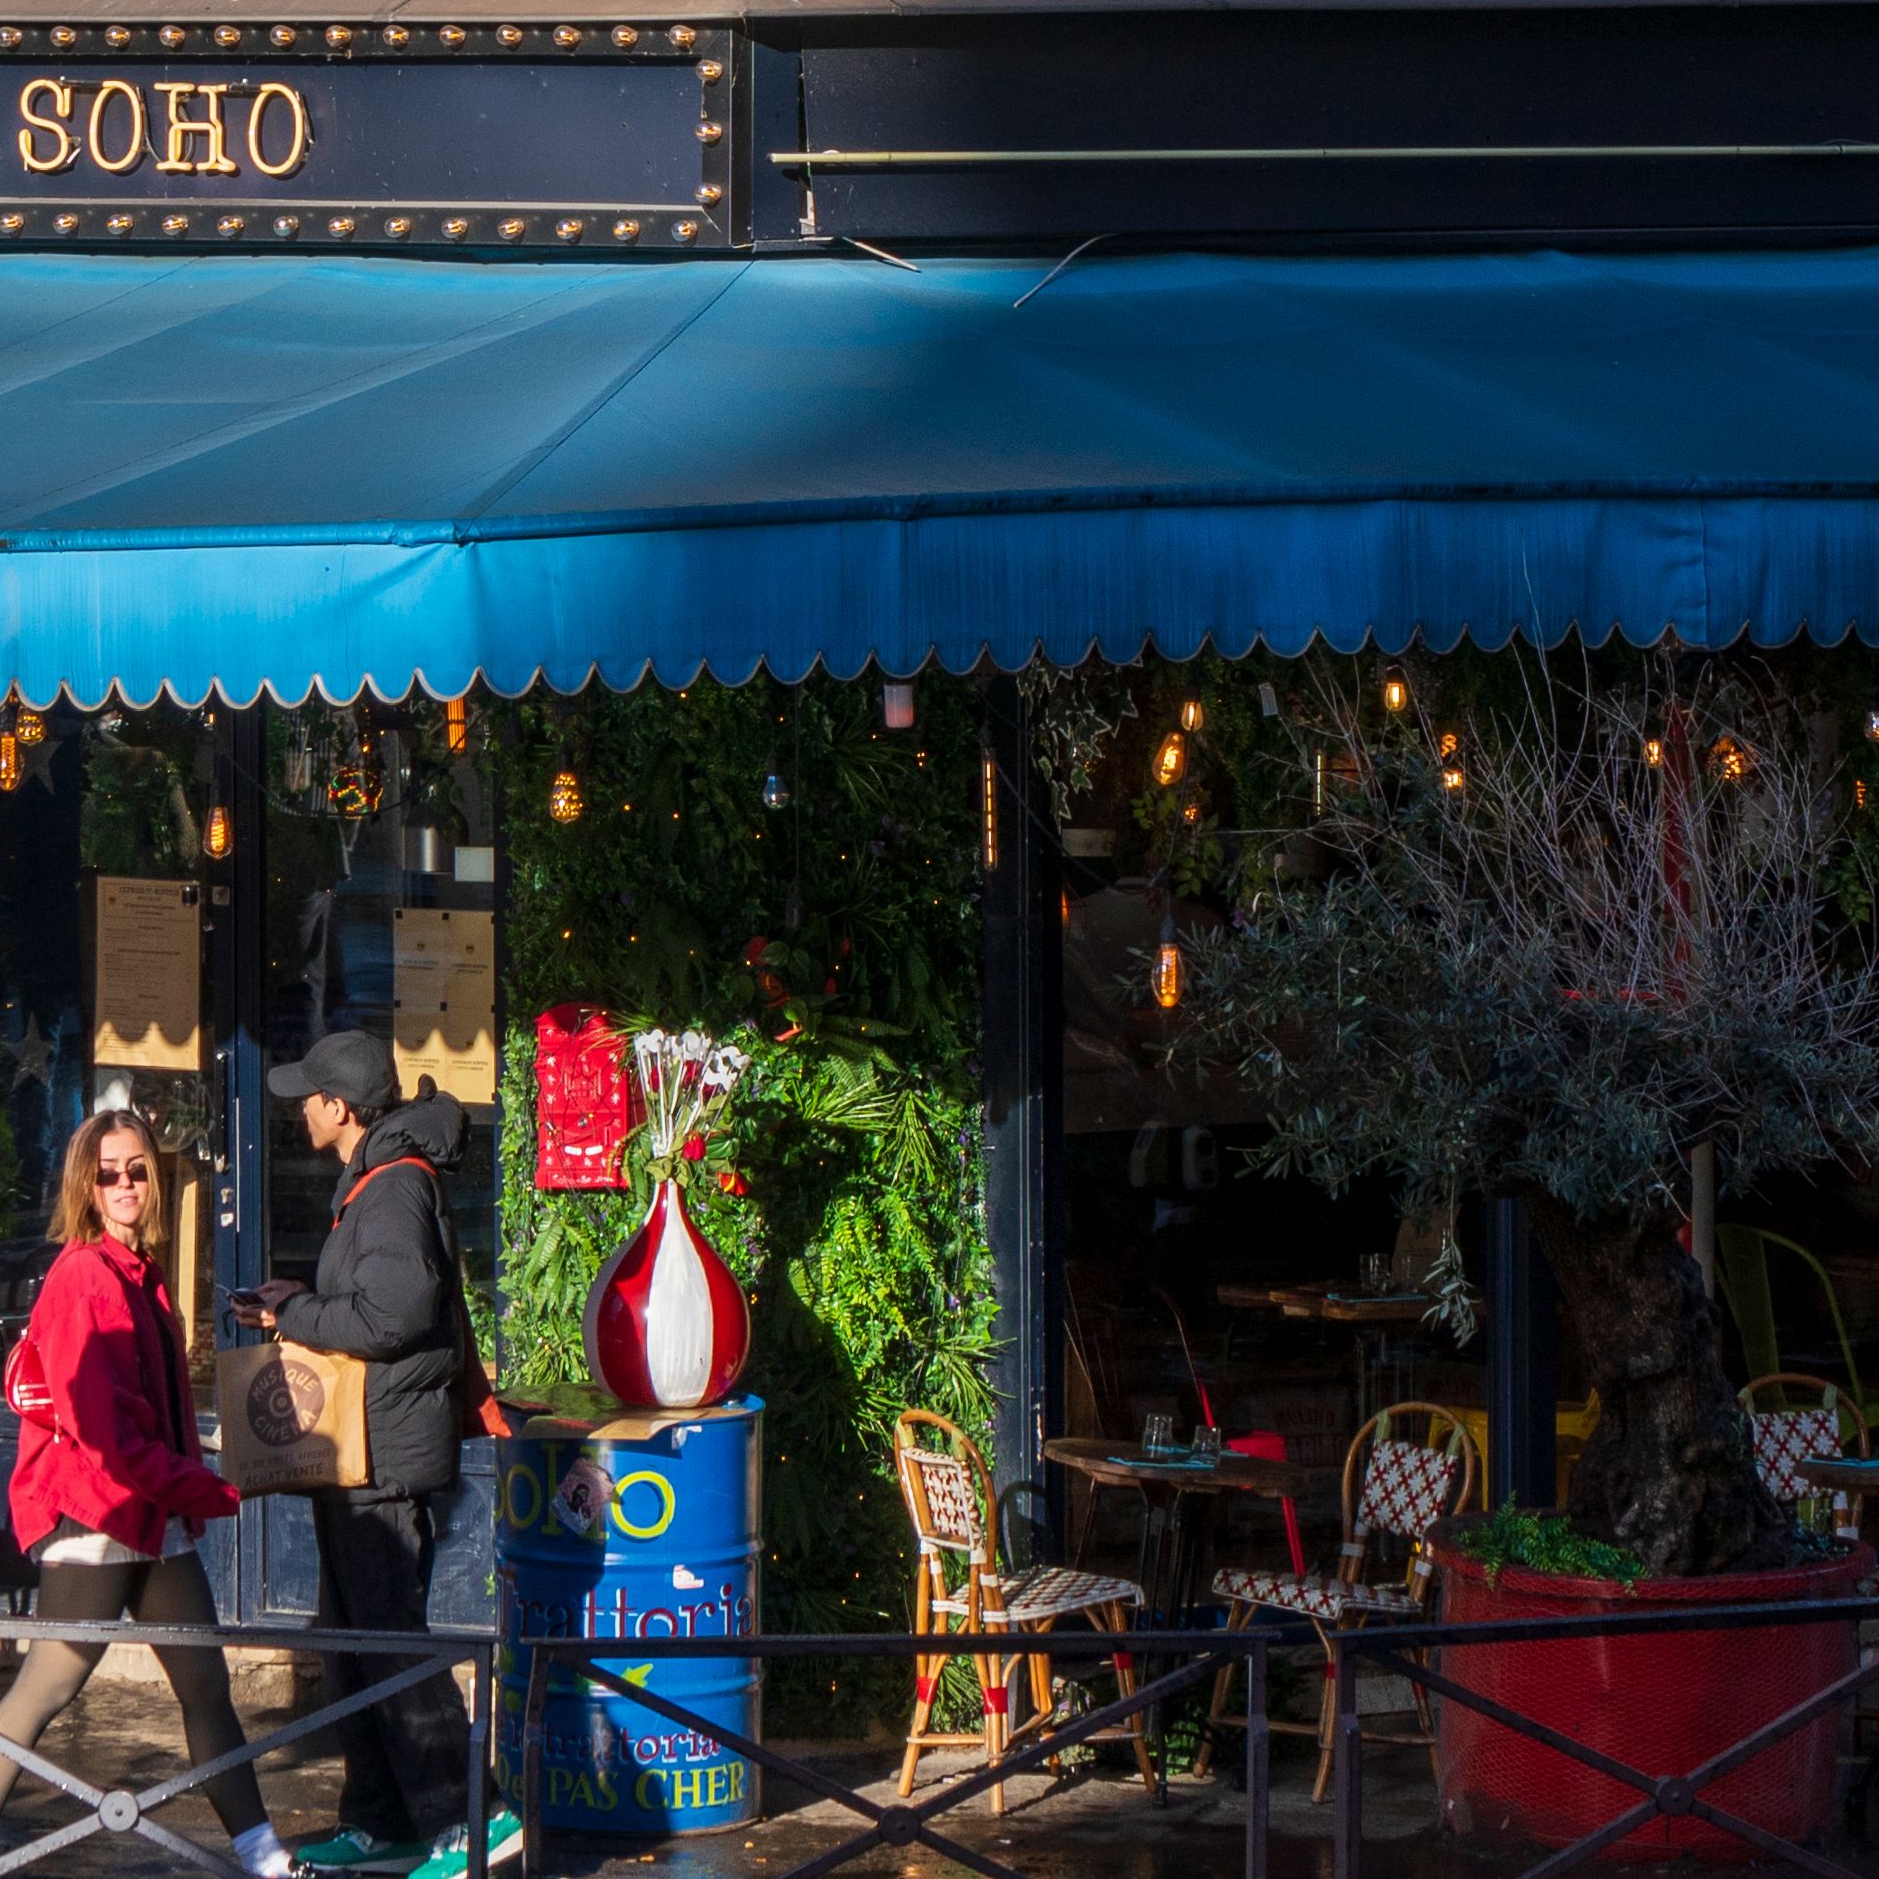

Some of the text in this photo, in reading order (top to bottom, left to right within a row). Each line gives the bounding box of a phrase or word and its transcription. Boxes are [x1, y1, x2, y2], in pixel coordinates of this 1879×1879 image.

[18, 78, 305, 177] SOHO
[252, 1367, 319, 1402] MUSIQUE
[285, 1463, 324, 1482] VENTE
[548, 1767, 619, 1812] PAS
[635, 1761, 745, 1811] CHER
